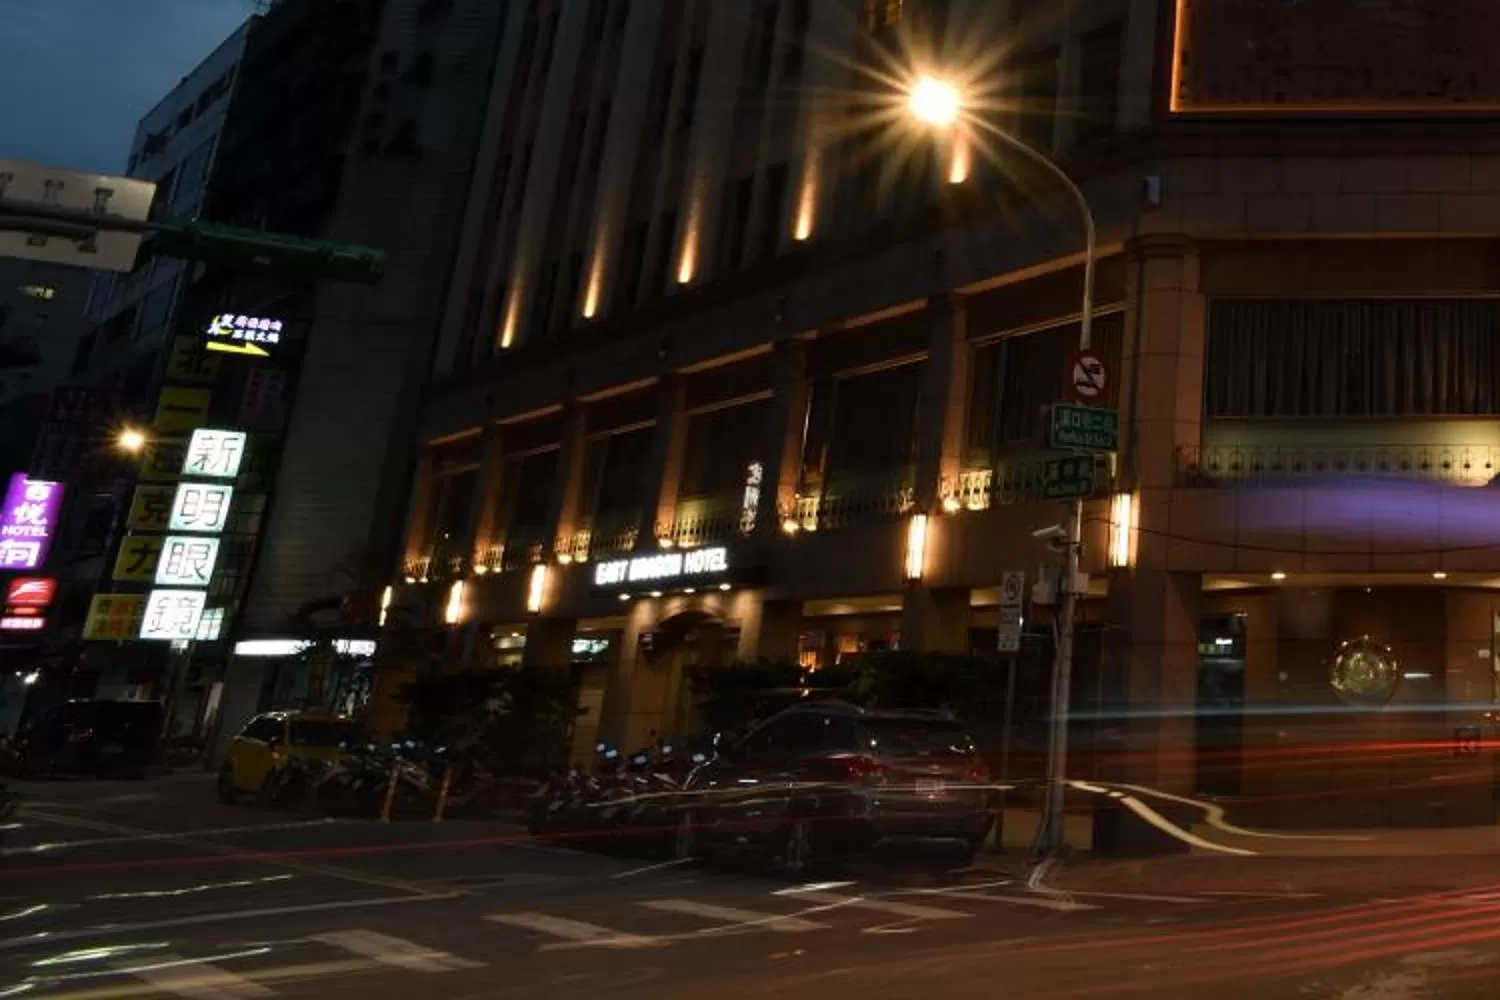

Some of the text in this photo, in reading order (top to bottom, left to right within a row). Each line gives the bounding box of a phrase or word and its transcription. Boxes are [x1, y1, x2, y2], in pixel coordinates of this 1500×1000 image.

[150, 437, 239, 633] 新明眼鏡
[684, 547, 728, 575] HOTEL
